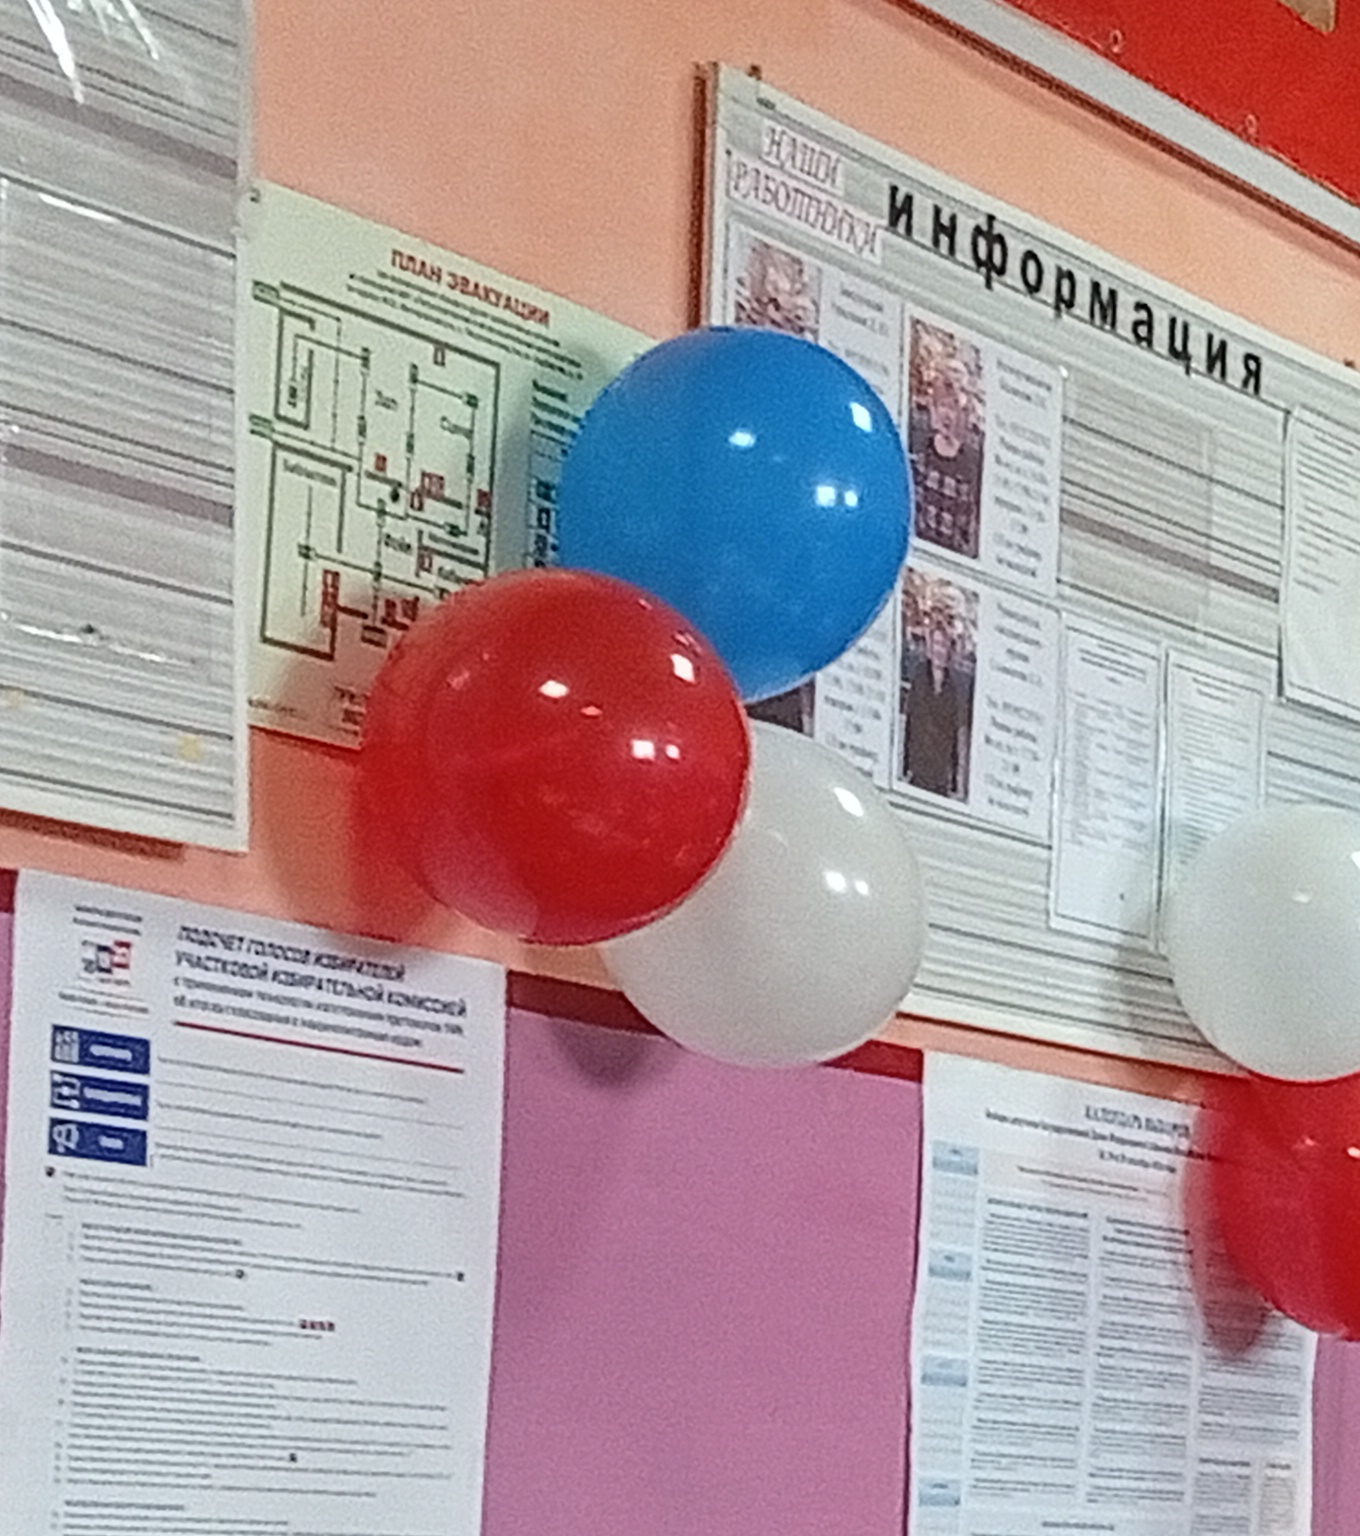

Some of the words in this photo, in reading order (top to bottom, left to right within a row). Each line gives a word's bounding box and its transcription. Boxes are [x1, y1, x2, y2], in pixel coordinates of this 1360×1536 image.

[766, 126, 840, 187] НАШИ
[733, 160, 876, 254] РАБОТНИКИ
[392, 249, 442, 285] ПЛАН
[446, 271, 550, 327] ЭВАКУАЦИИ
[888, 184, 1262, 396] информация
[174, 950, 268, 981] УЧАСТКОВОЙ
[271, 969, 384, 1002] ИЗБИРАТЕЛЬНОЙ
